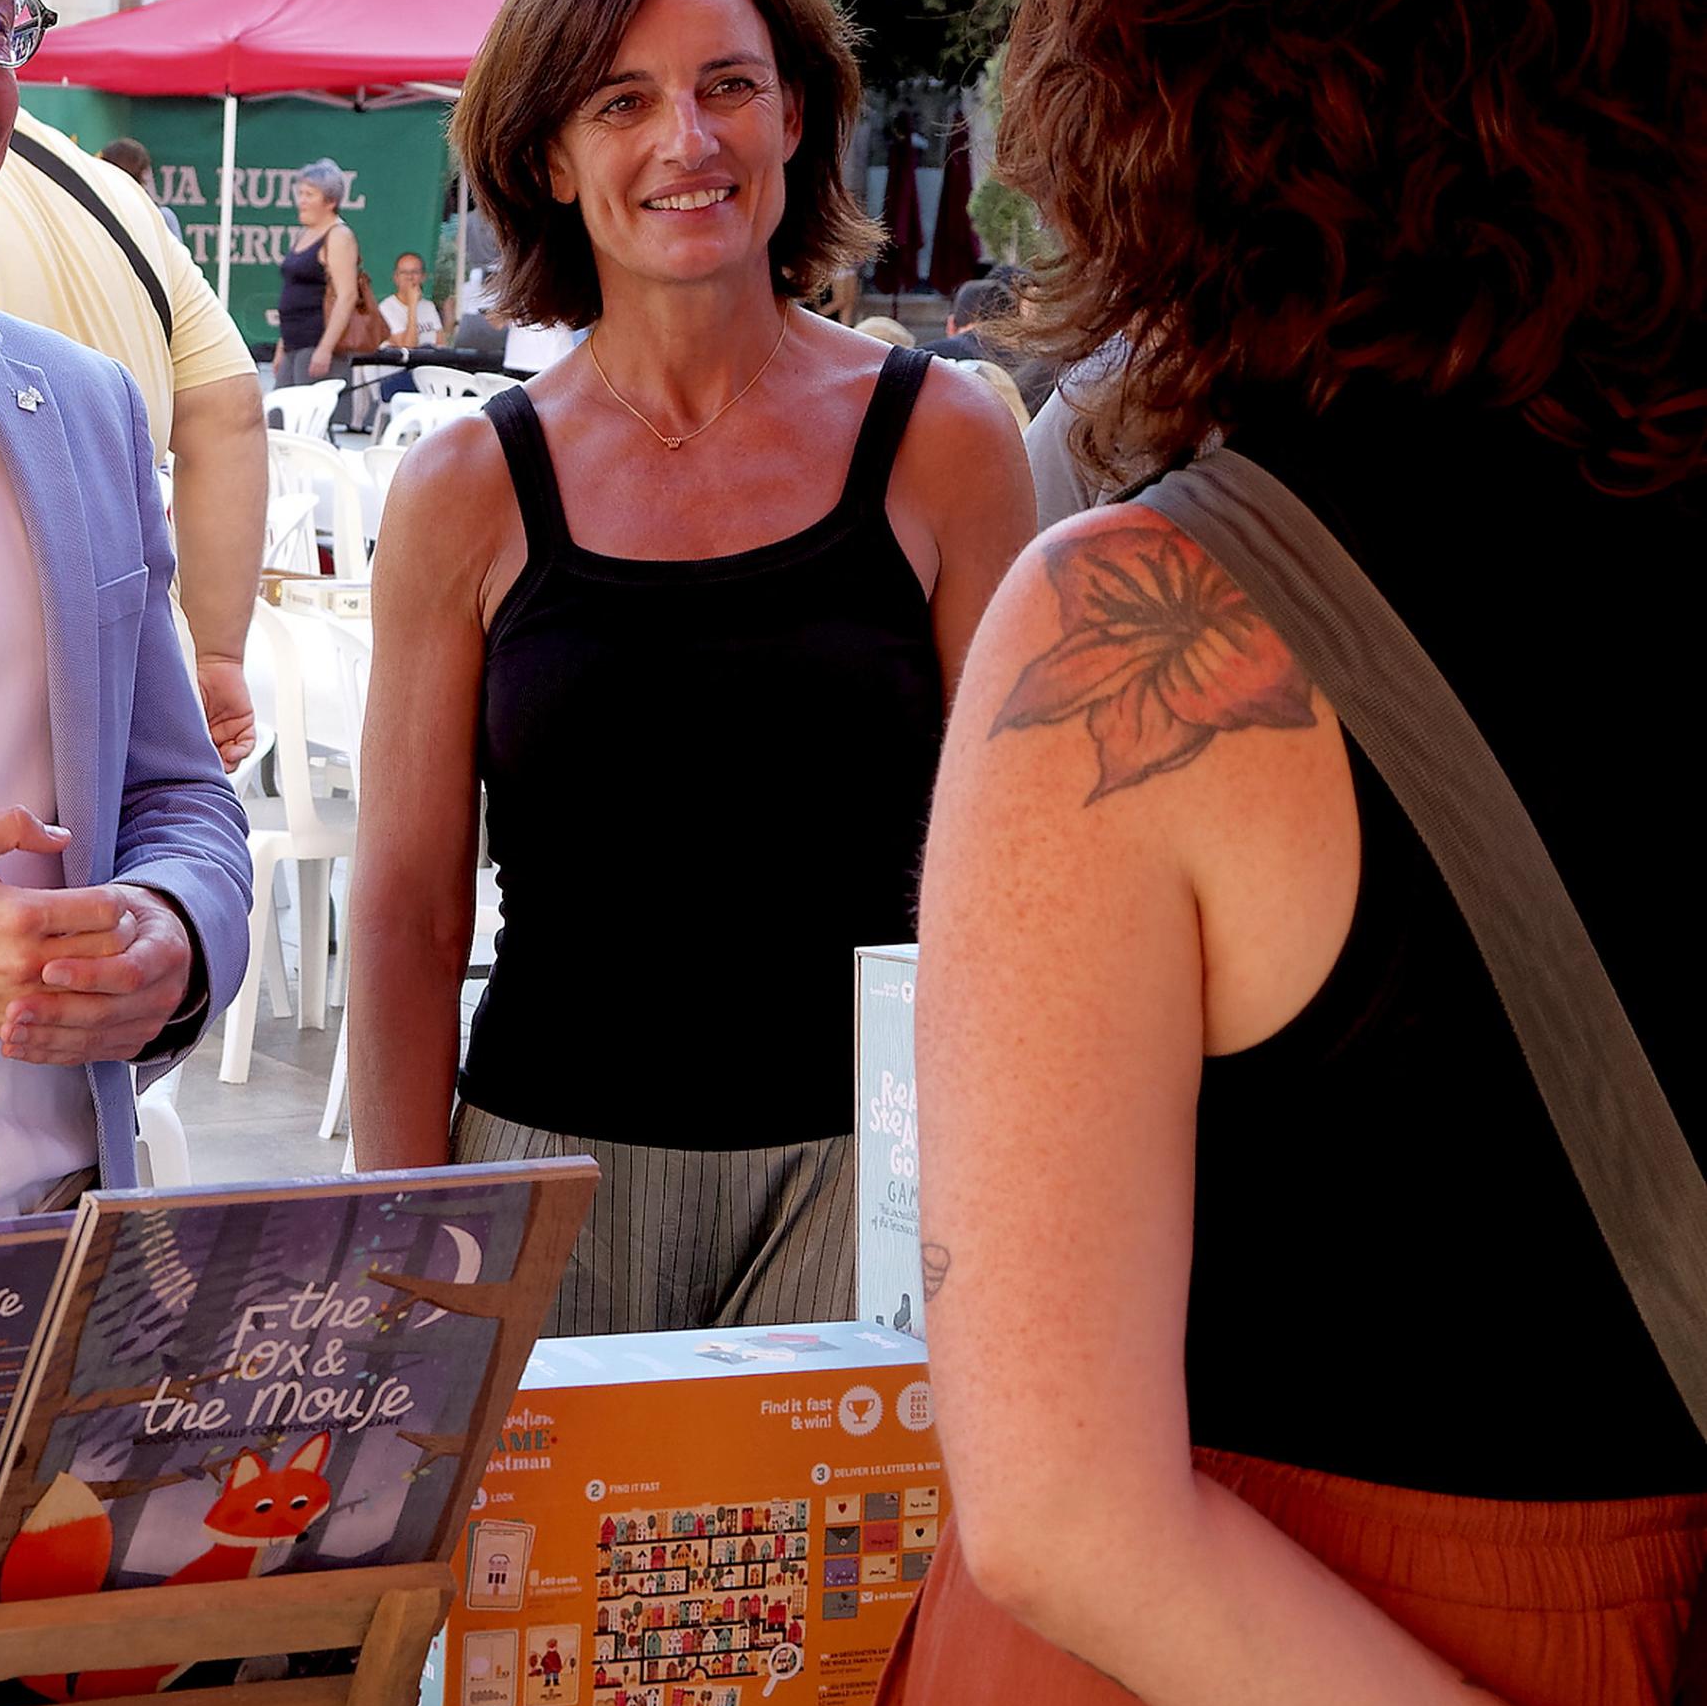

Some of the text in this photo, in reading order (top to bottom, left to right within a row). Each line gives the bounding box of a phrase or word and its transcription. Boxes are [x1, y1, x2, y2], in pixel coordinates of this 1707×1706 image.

[888, 1181, 918, 1209] GAM
[290, 1282, 371, 1330] the
[219, 1304, 347, 1384] Fox &
[760, 1397, 833, 1415] Find it fast
[791, 1414, 833, 1430] & win!
[494, 1429, 551, 1453] AME
[485, 1456, 552, 1474] ostman
[816, 1466, 826, 1481] 3
[834, 1467, 869, 1478] DELIVER
[882, 1463, 916, 1475] LETTERS
[490, 1493, 515, 1503] LOOK
[590, 1482, 661, 1498] 2 FIND IT FAST
